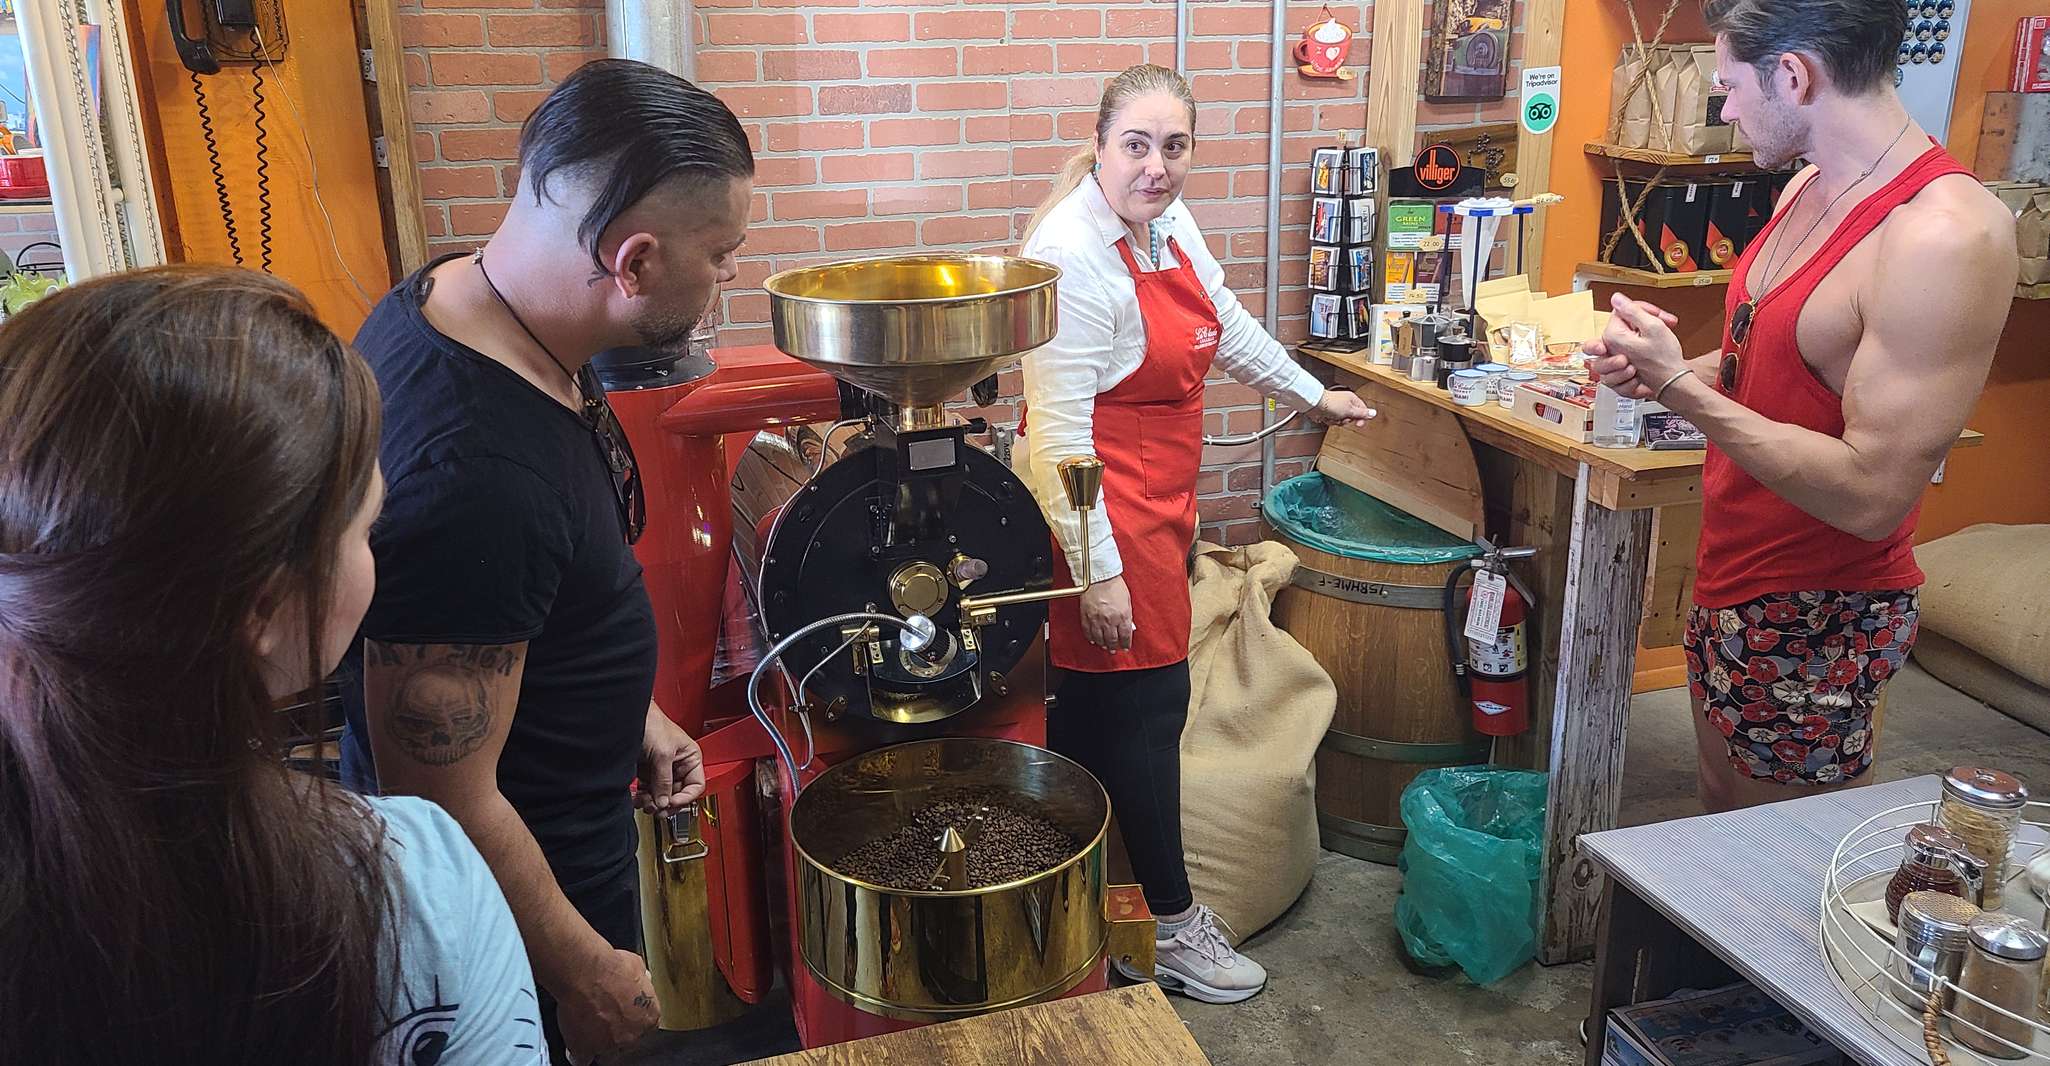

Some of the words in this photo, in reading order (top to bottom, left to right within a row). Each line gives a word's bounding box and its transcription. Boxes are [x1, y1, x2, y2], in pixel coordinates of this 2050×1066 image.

[1526, 79, 1558, 87] Tripadvisor
[1420, 149, 1456, 185] villiger
[1395, 215, 1426, 223] GREEN
